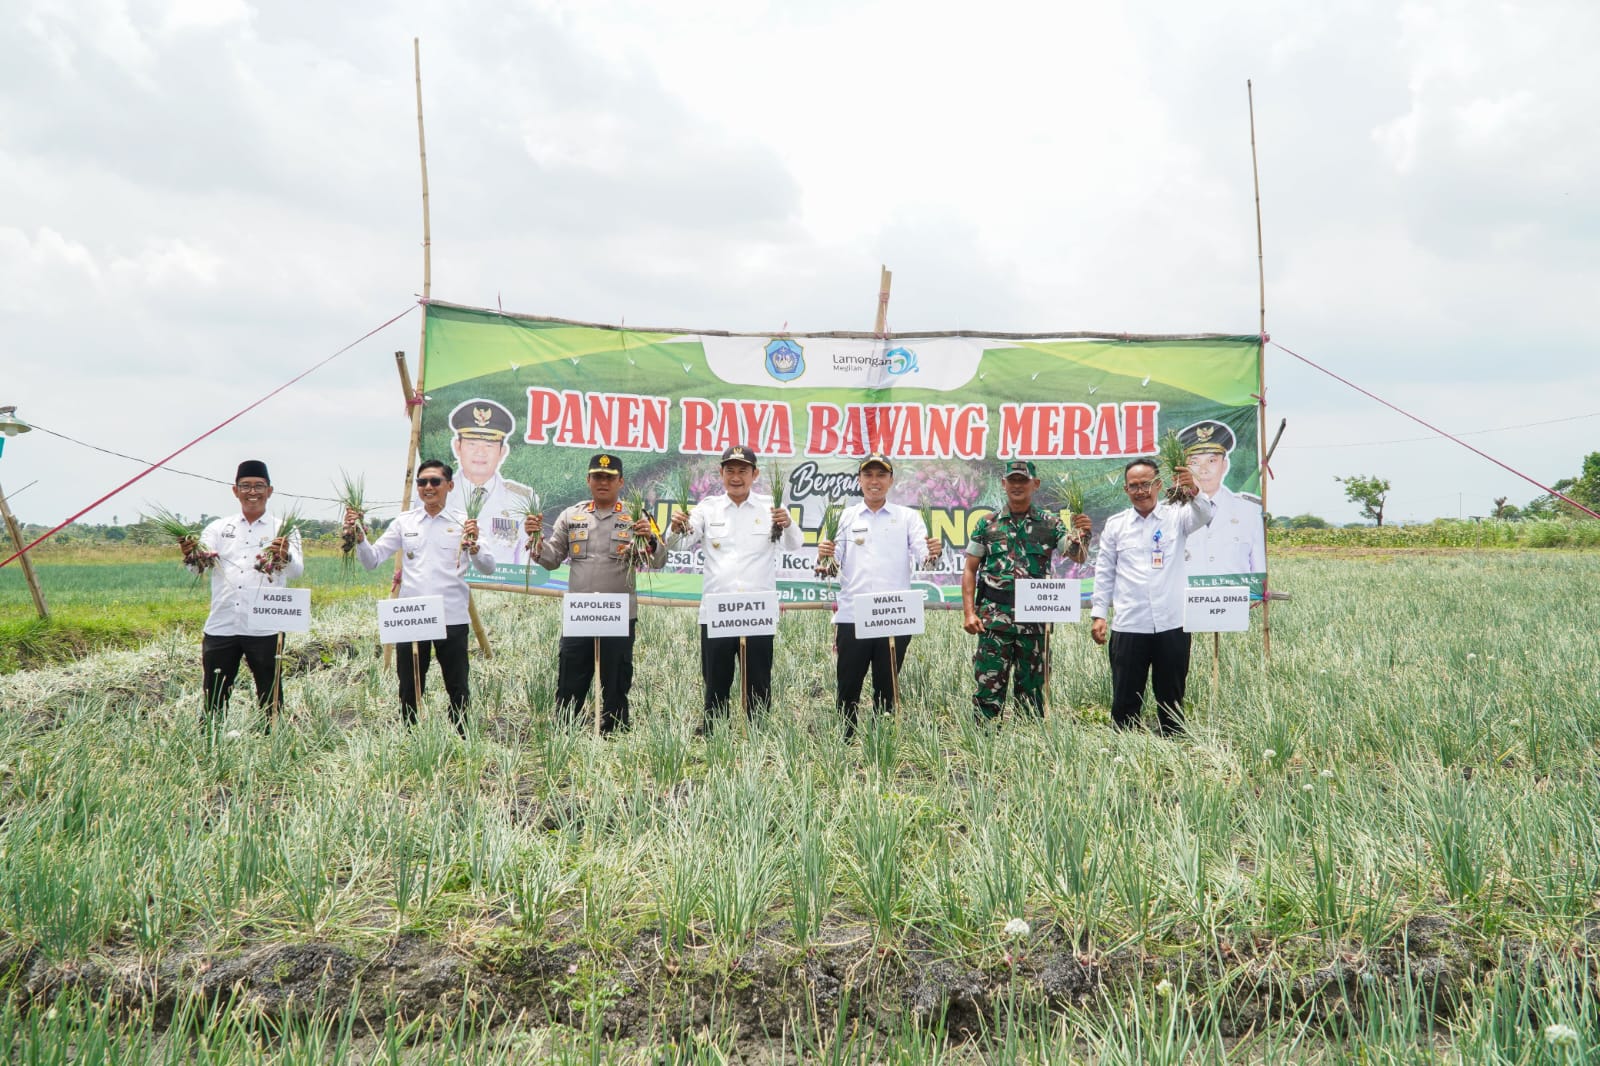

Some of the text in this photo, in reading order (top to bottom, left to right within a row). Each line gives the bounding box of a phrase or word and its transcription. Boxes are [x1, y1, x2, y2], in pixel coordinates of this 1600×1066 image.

[833, 354, 892, 367] Lamongan
[527, 388, 1158, 457] PANEN RAYA BAWANG MERAH
[782, 553, 815, 570] Kec.
[1030, 582, 1066, 590] DANDIM
[263, 593, 293, 603] KADES
[801, 588, 816, 601] 10
[873, 595, 904, 604] WAKIL
[1188, 595, 1248, 604] KEPALA DINAS
[392, 604, 426, 614] CAMAT
[569, 601, 622, 609] KAPOLRES
[718, 601, 765, 613] BUPATI
[252, 606, 302, 617] SUKORAME
[871, 606, 906, 616] BUPATI
[383, 616, 438, 628] SUKORAME
[570, 614, 621, 622] LAMONGAN
[711, 617, 773, 629] LAMONGAN
[864, 617, 916, 628] LAMONGAN
